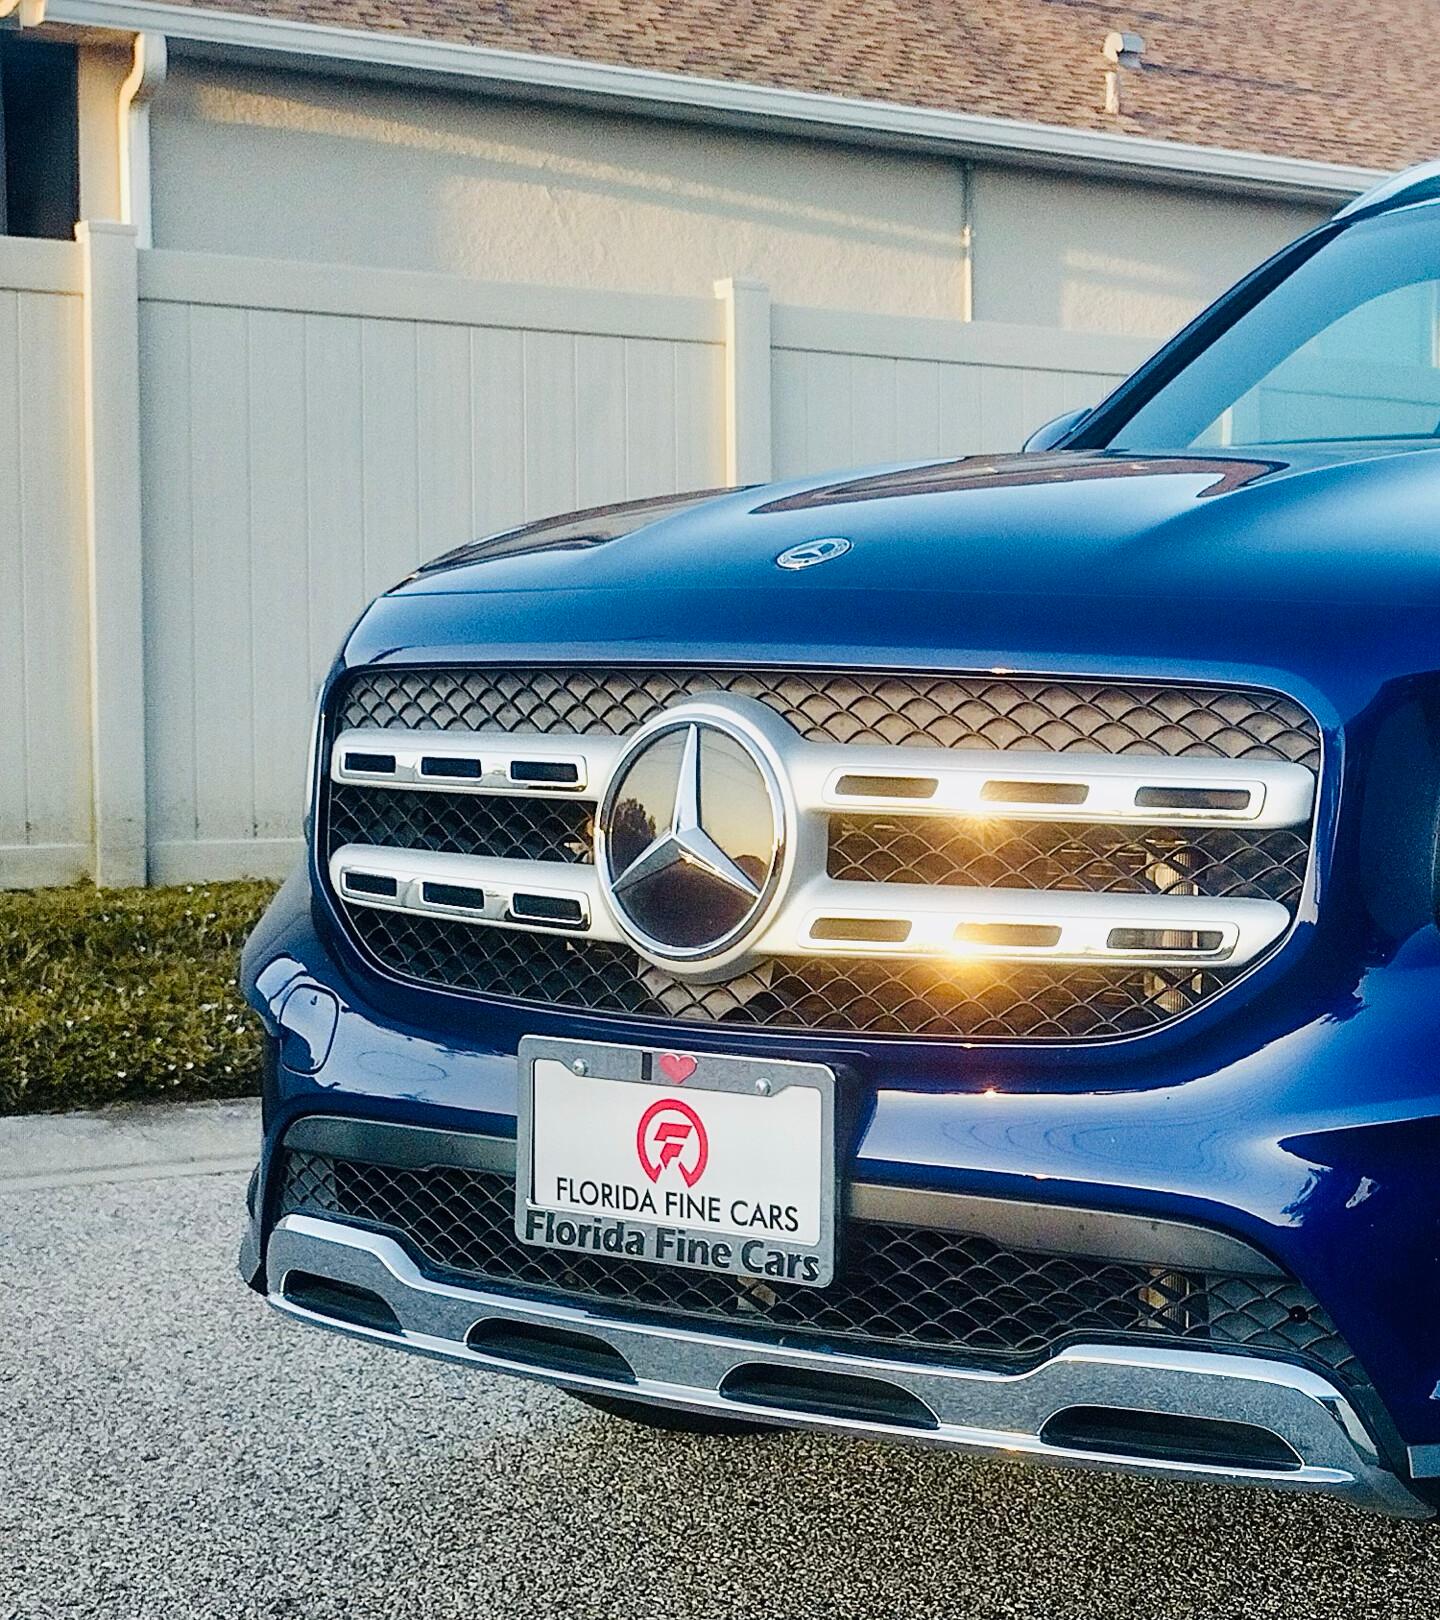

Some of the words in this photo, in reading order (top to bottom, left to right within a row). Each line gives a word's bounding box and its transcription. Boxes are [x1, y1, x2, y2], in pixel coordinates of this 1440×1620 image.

[556, 1177, 657, 1216] FLORIDA
[665, 1191, 721, 1223] FINE
[731, 1200, 800, 1233] CARS
[525, 1209, 645, 1256] Florida
[655, 1226, 732, 1269] Fine
[741, 1240, 820, 1282] Cars
